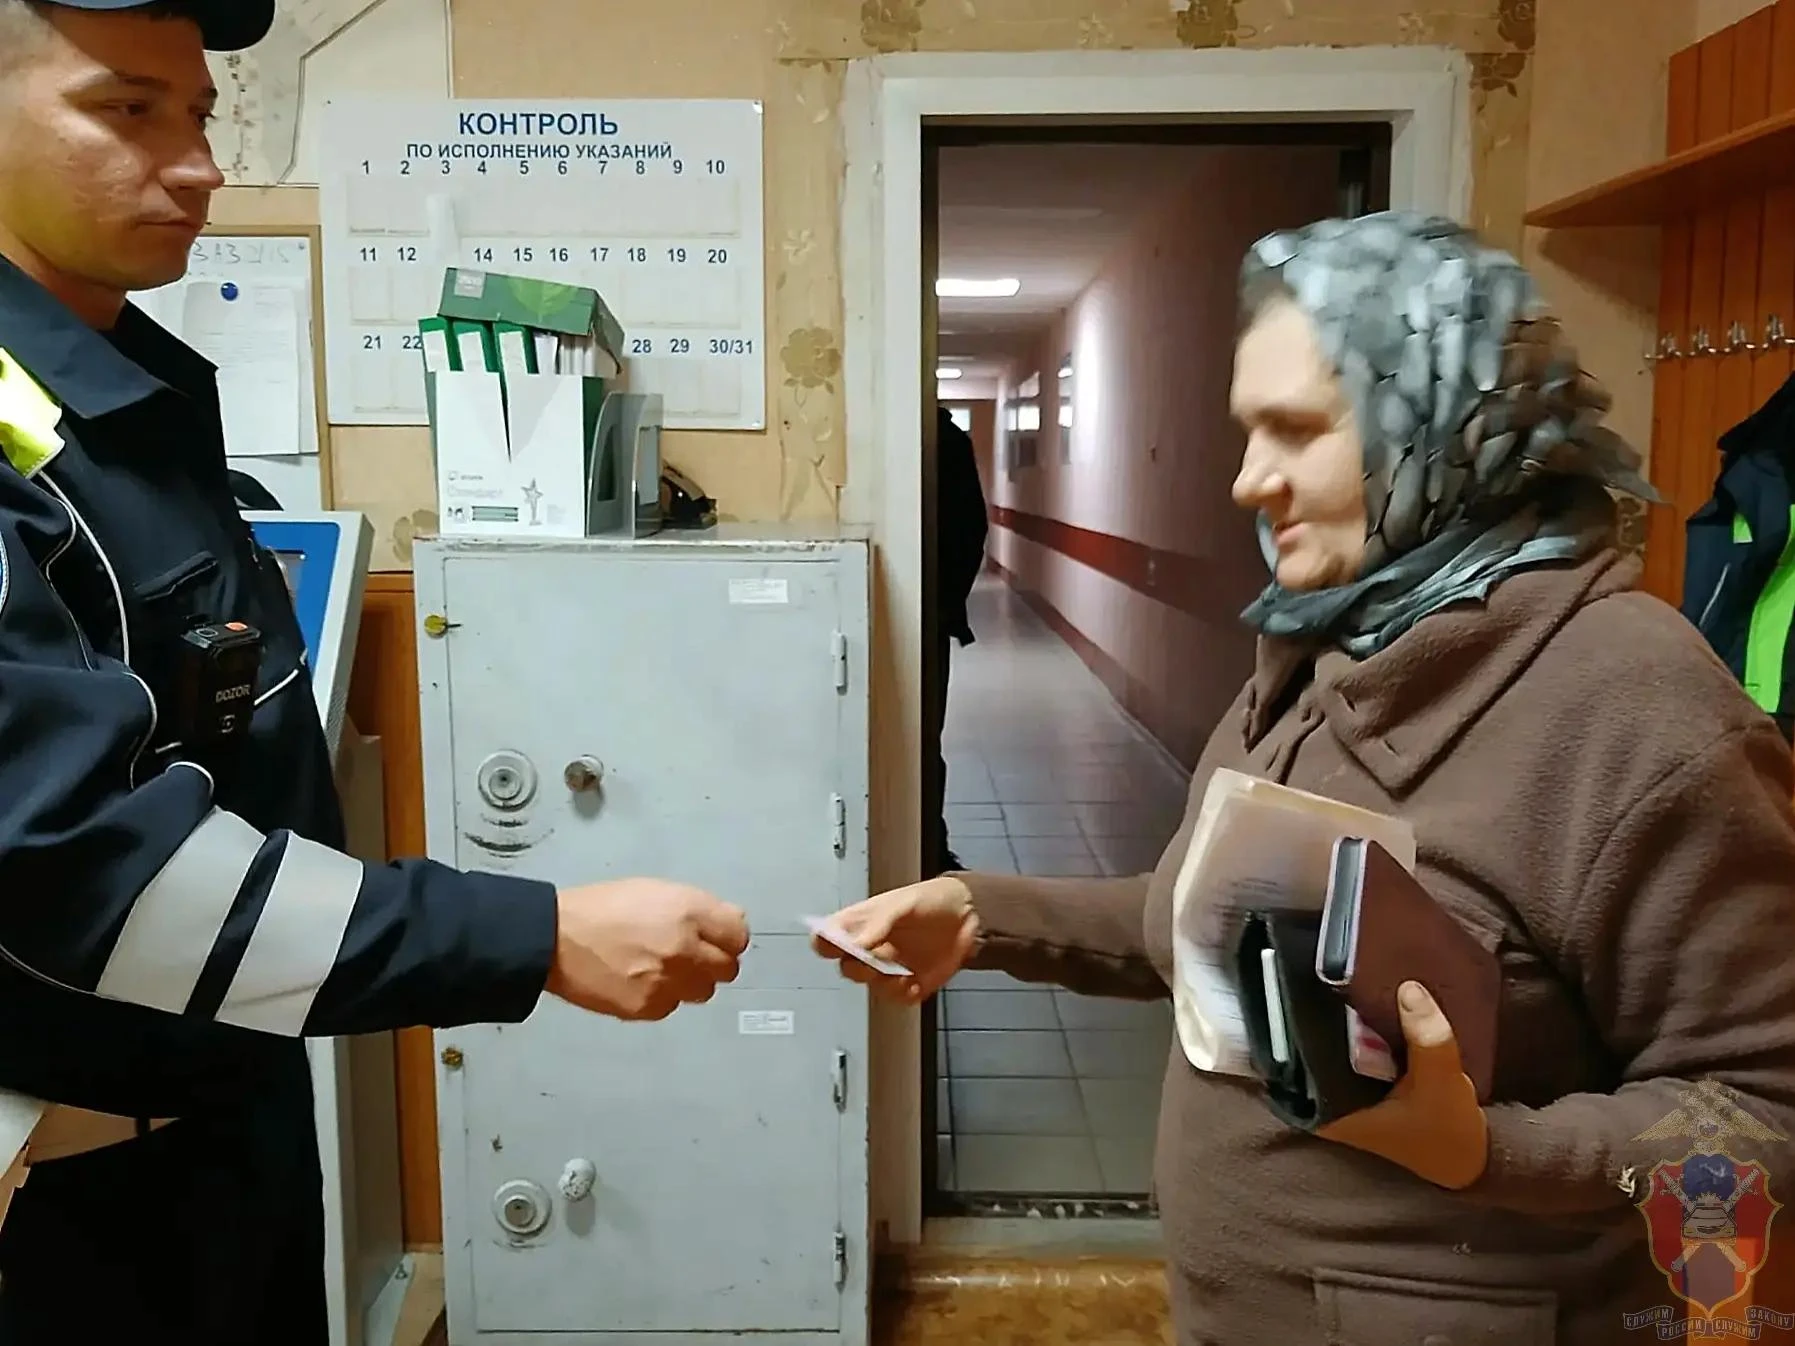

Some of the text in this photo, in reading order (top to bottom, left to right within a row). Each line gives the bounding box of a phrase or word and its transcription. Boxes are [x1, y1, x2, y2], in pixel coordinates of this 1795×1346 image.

[459, 112, 619, 136] КОНТРОЛЬ
[407, 141, 672, 159] ПО ИСПОЛНЕНИЮ УКАЗАНИЙ
[362, 159, 725, 175] 1 2 3 4 5 6 7 8 9 10
[360, 247, 727, 264] 11 12 14 15 16 17 18 19 20
[363, 335, 381, 350] 21
[632, 339, 652, 354] 28
[670, 338, 690, 353] 29
[710, 339, 753, 355] 30/31
